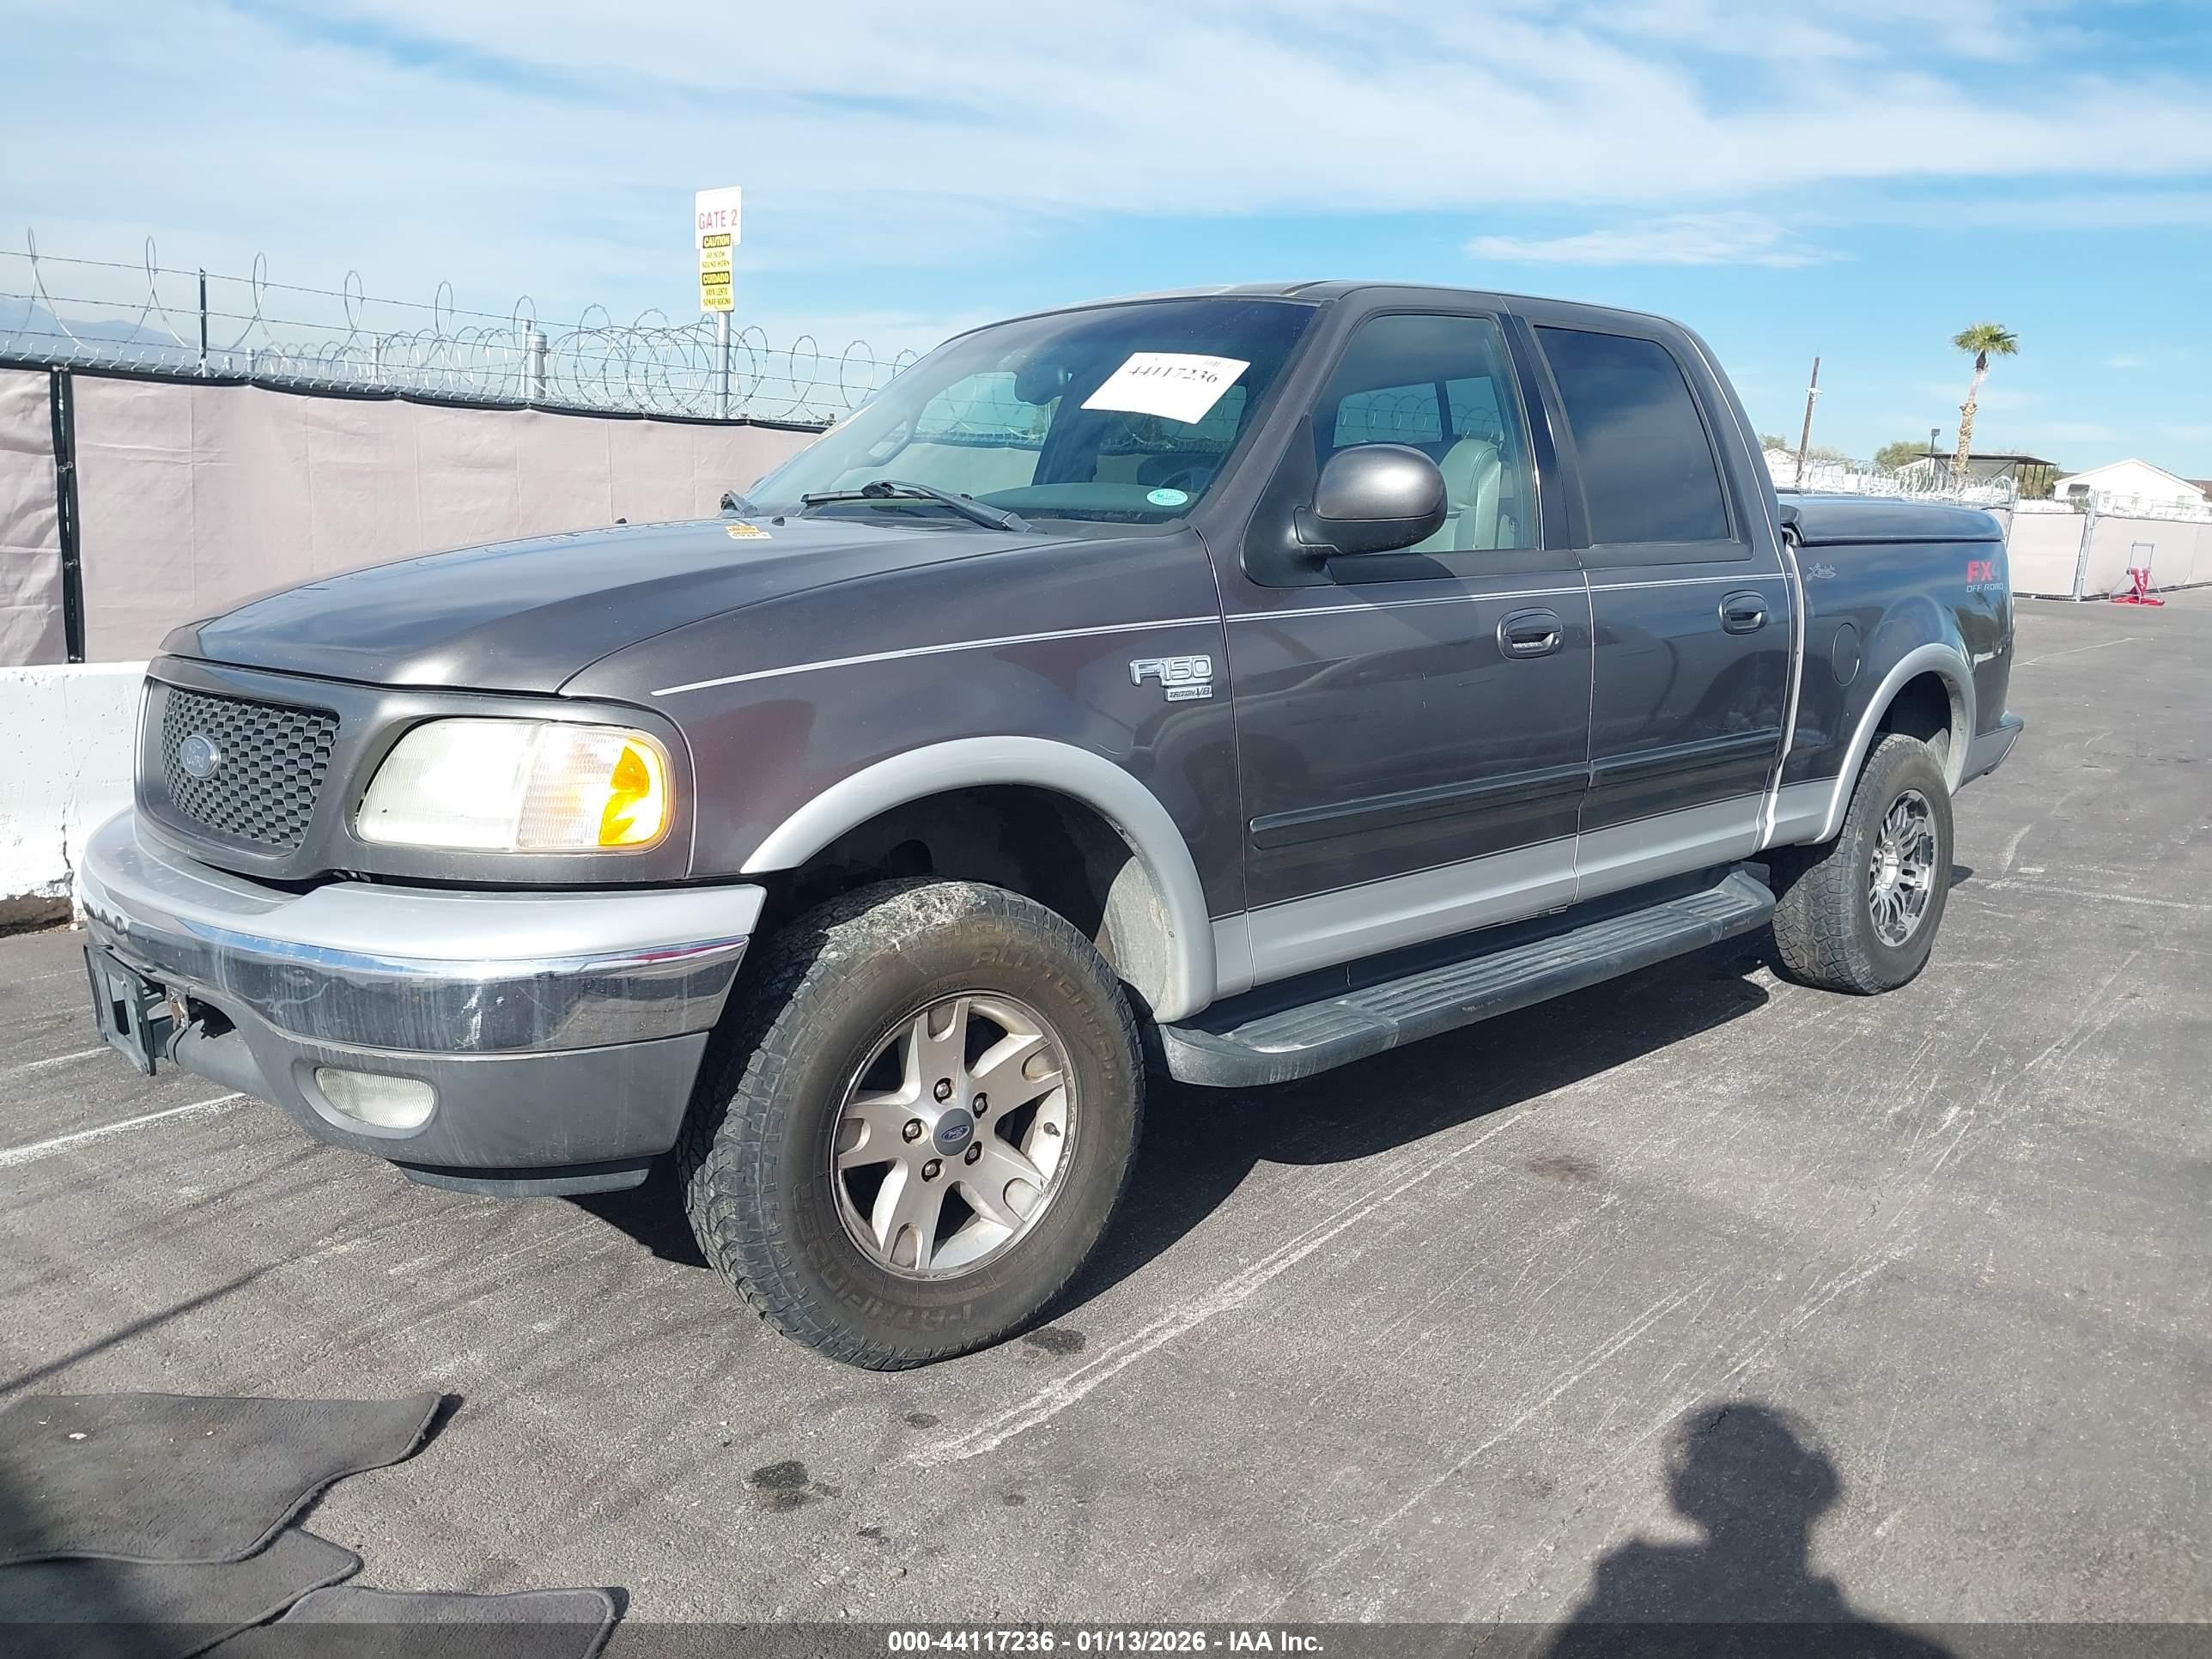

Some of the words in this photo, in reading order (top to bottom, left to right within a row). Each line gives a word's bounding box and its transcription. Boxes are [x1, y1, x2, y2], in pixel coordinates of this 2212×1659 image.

[699, 210, 726, 229] GATE
[731, 209, 738, 227] 2
[705, 234, 730, 246] CAUTION
[703, 273, 729, 284] CUIDADO
[1128, 365, 1218, 383] 44117236
[1966, 585, 1983, 593] OFF
[1984, 583, 2004, 592] ROAD
[1196, 687, 1211, 697] V8
